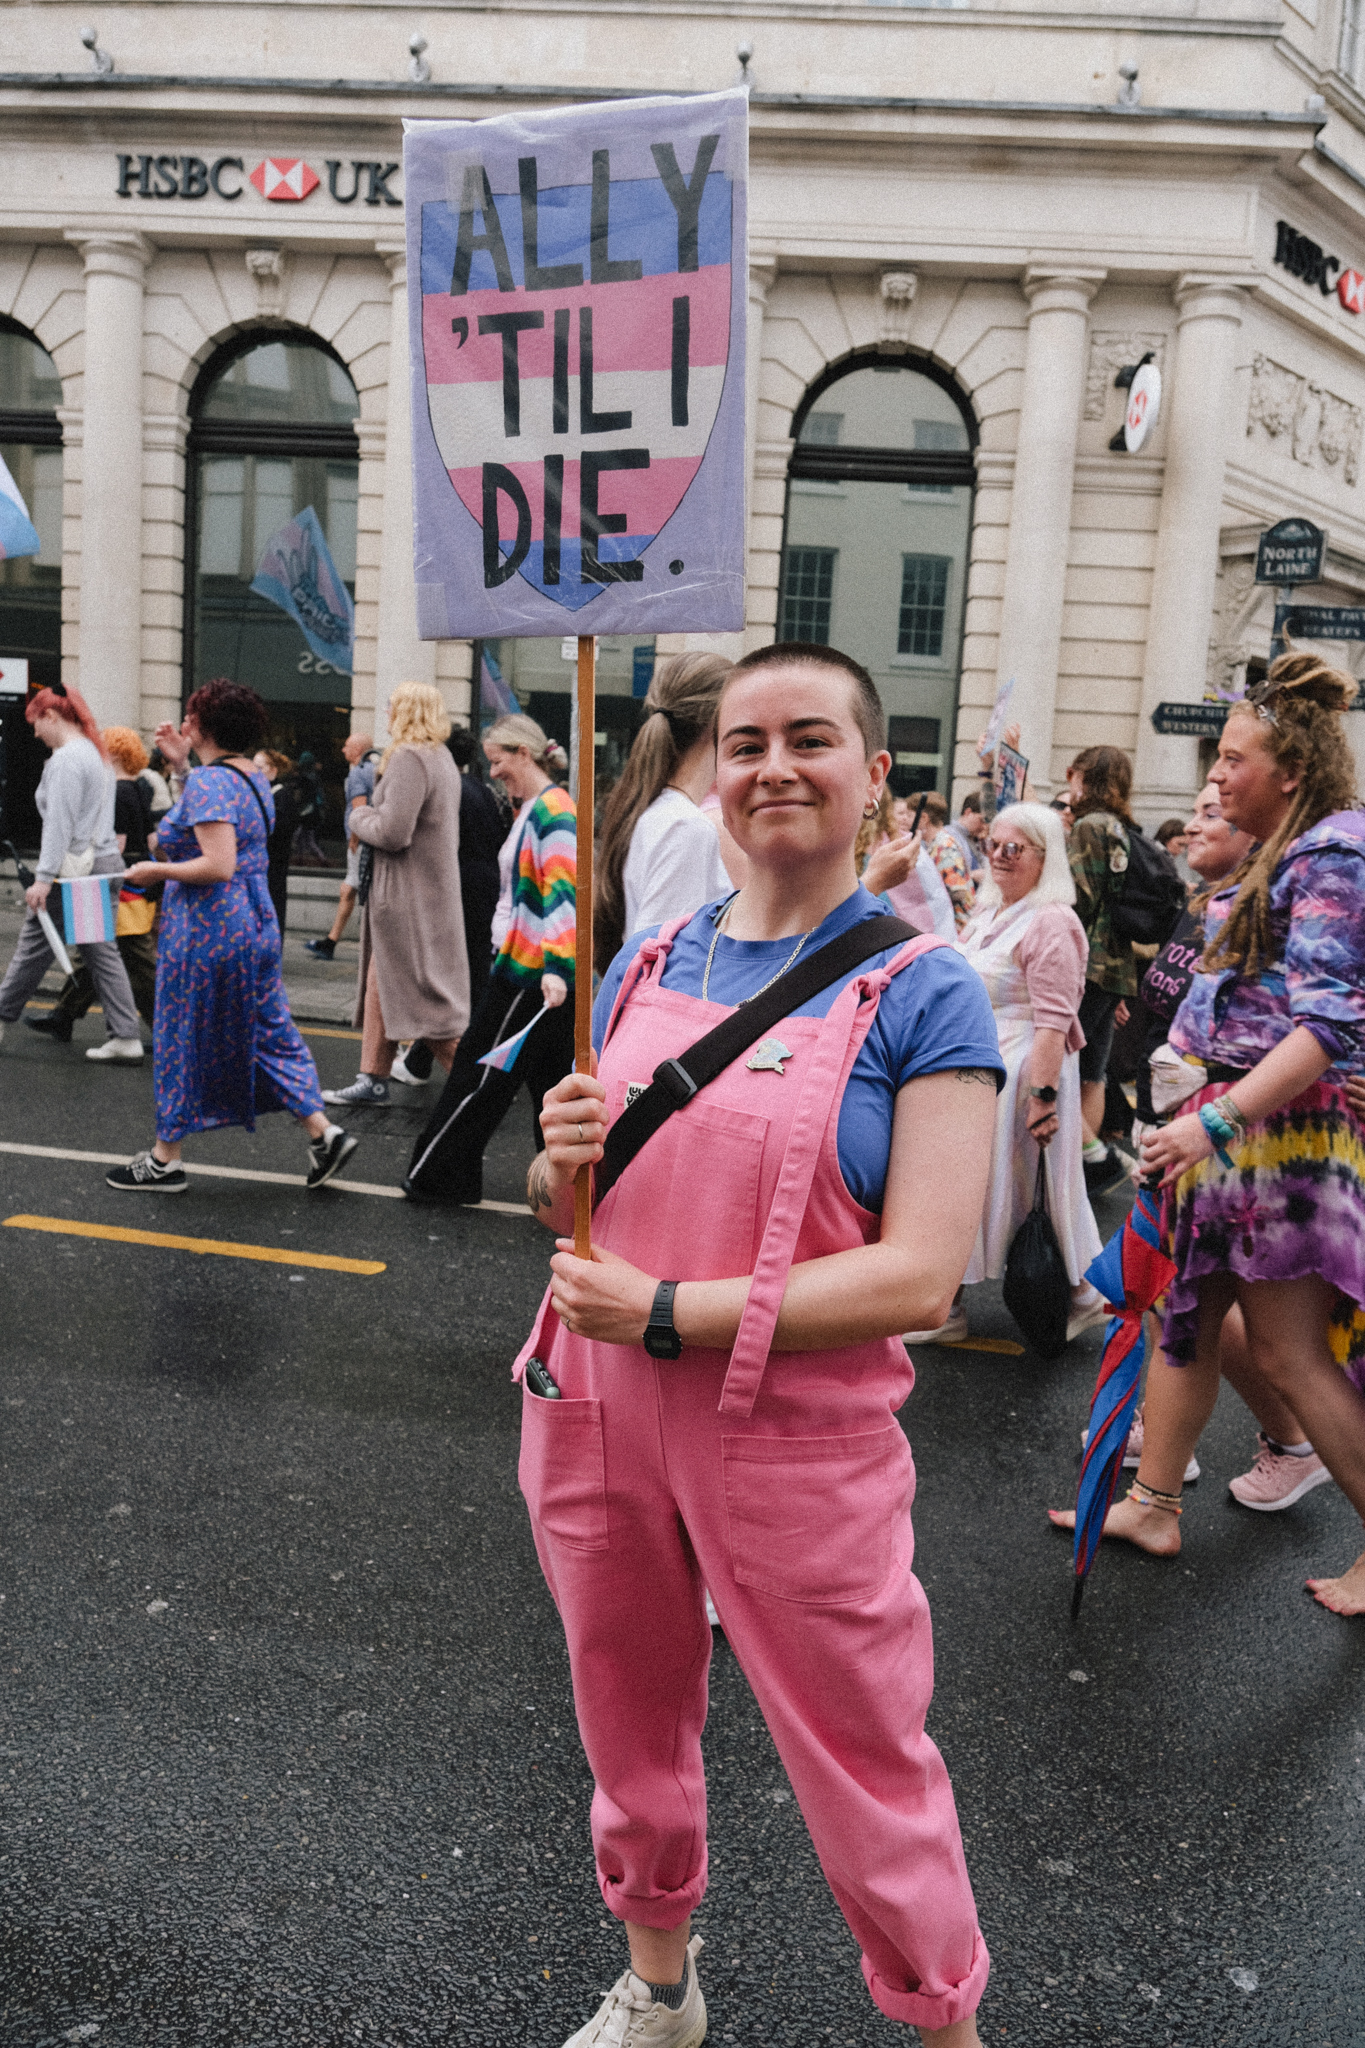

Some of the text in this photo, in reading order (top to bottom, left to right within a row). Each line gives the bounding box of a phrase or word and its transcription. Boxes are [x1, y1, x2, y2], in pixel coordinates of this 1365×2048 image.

[115, 154, 403, 206] HSBC UK
[450, 134, 721, 297] ALLY
[671, 295, 690, 427] I
[482, 448, 685, 589] DIE.
[1262, 546, 1318, 561] NORTH
[1264, 562, 1311, 577] LAINE
